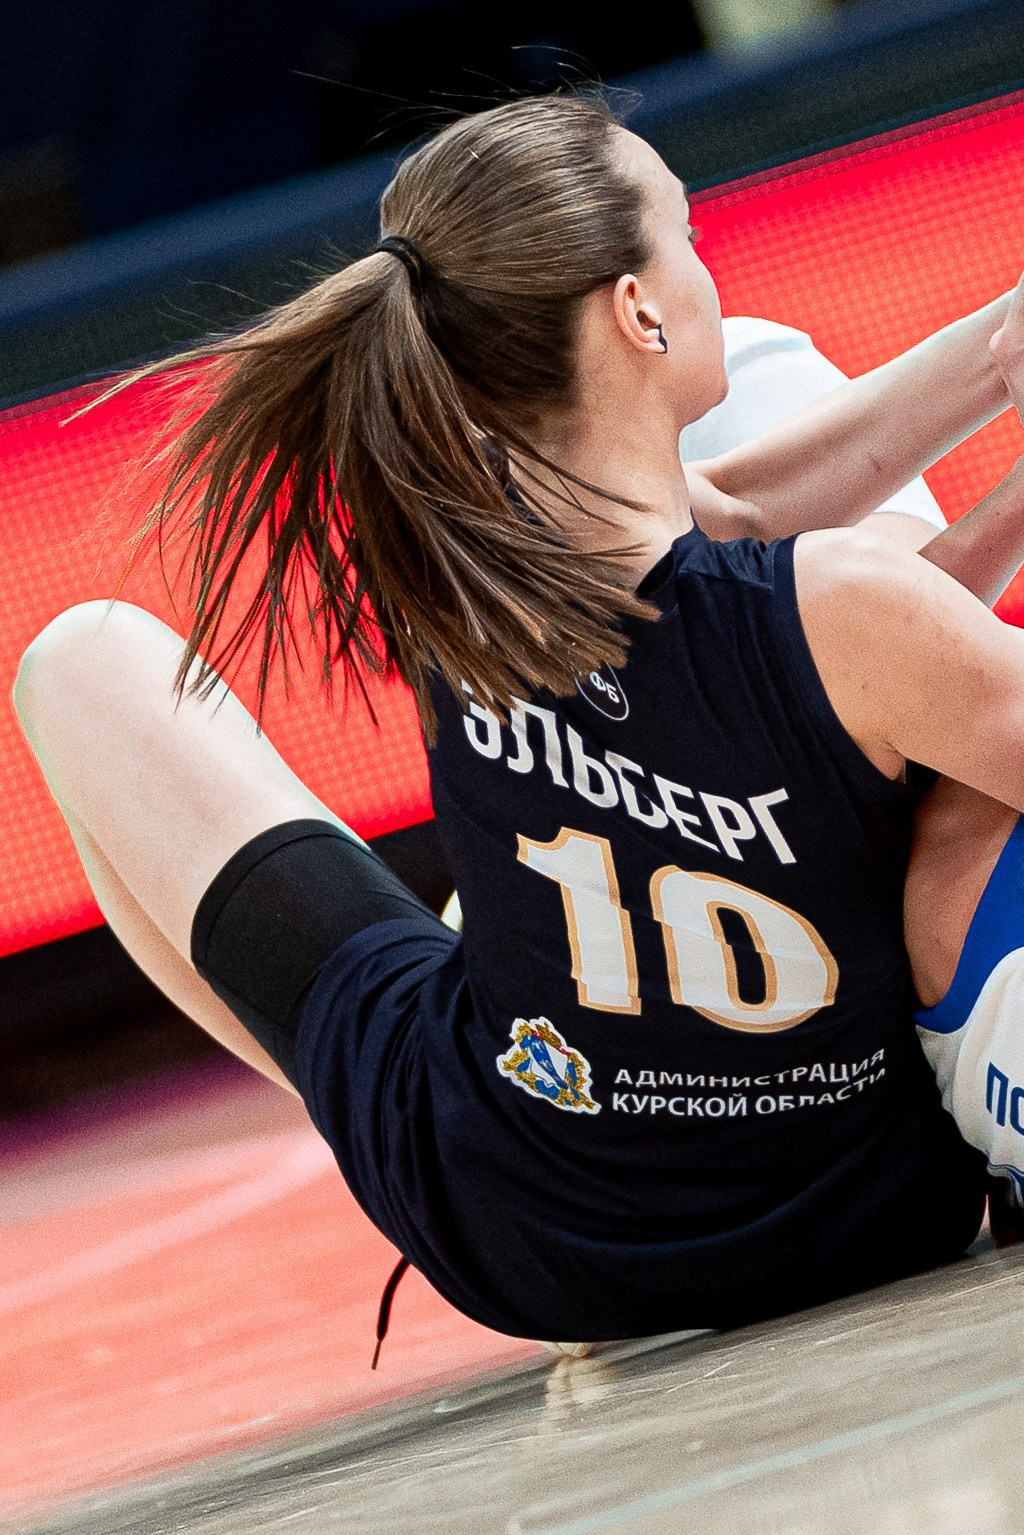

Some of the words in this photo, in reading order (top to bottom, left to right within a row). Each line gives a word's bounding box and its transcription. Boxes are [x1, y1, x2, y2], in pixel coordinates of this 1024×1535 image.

[517, 827, 839, 1034] 10
[614, 1048, 885, 1089] АДМИНИСТРАЦИЯ
[612, 1092, 747, 1117] КУРСКОЙ
